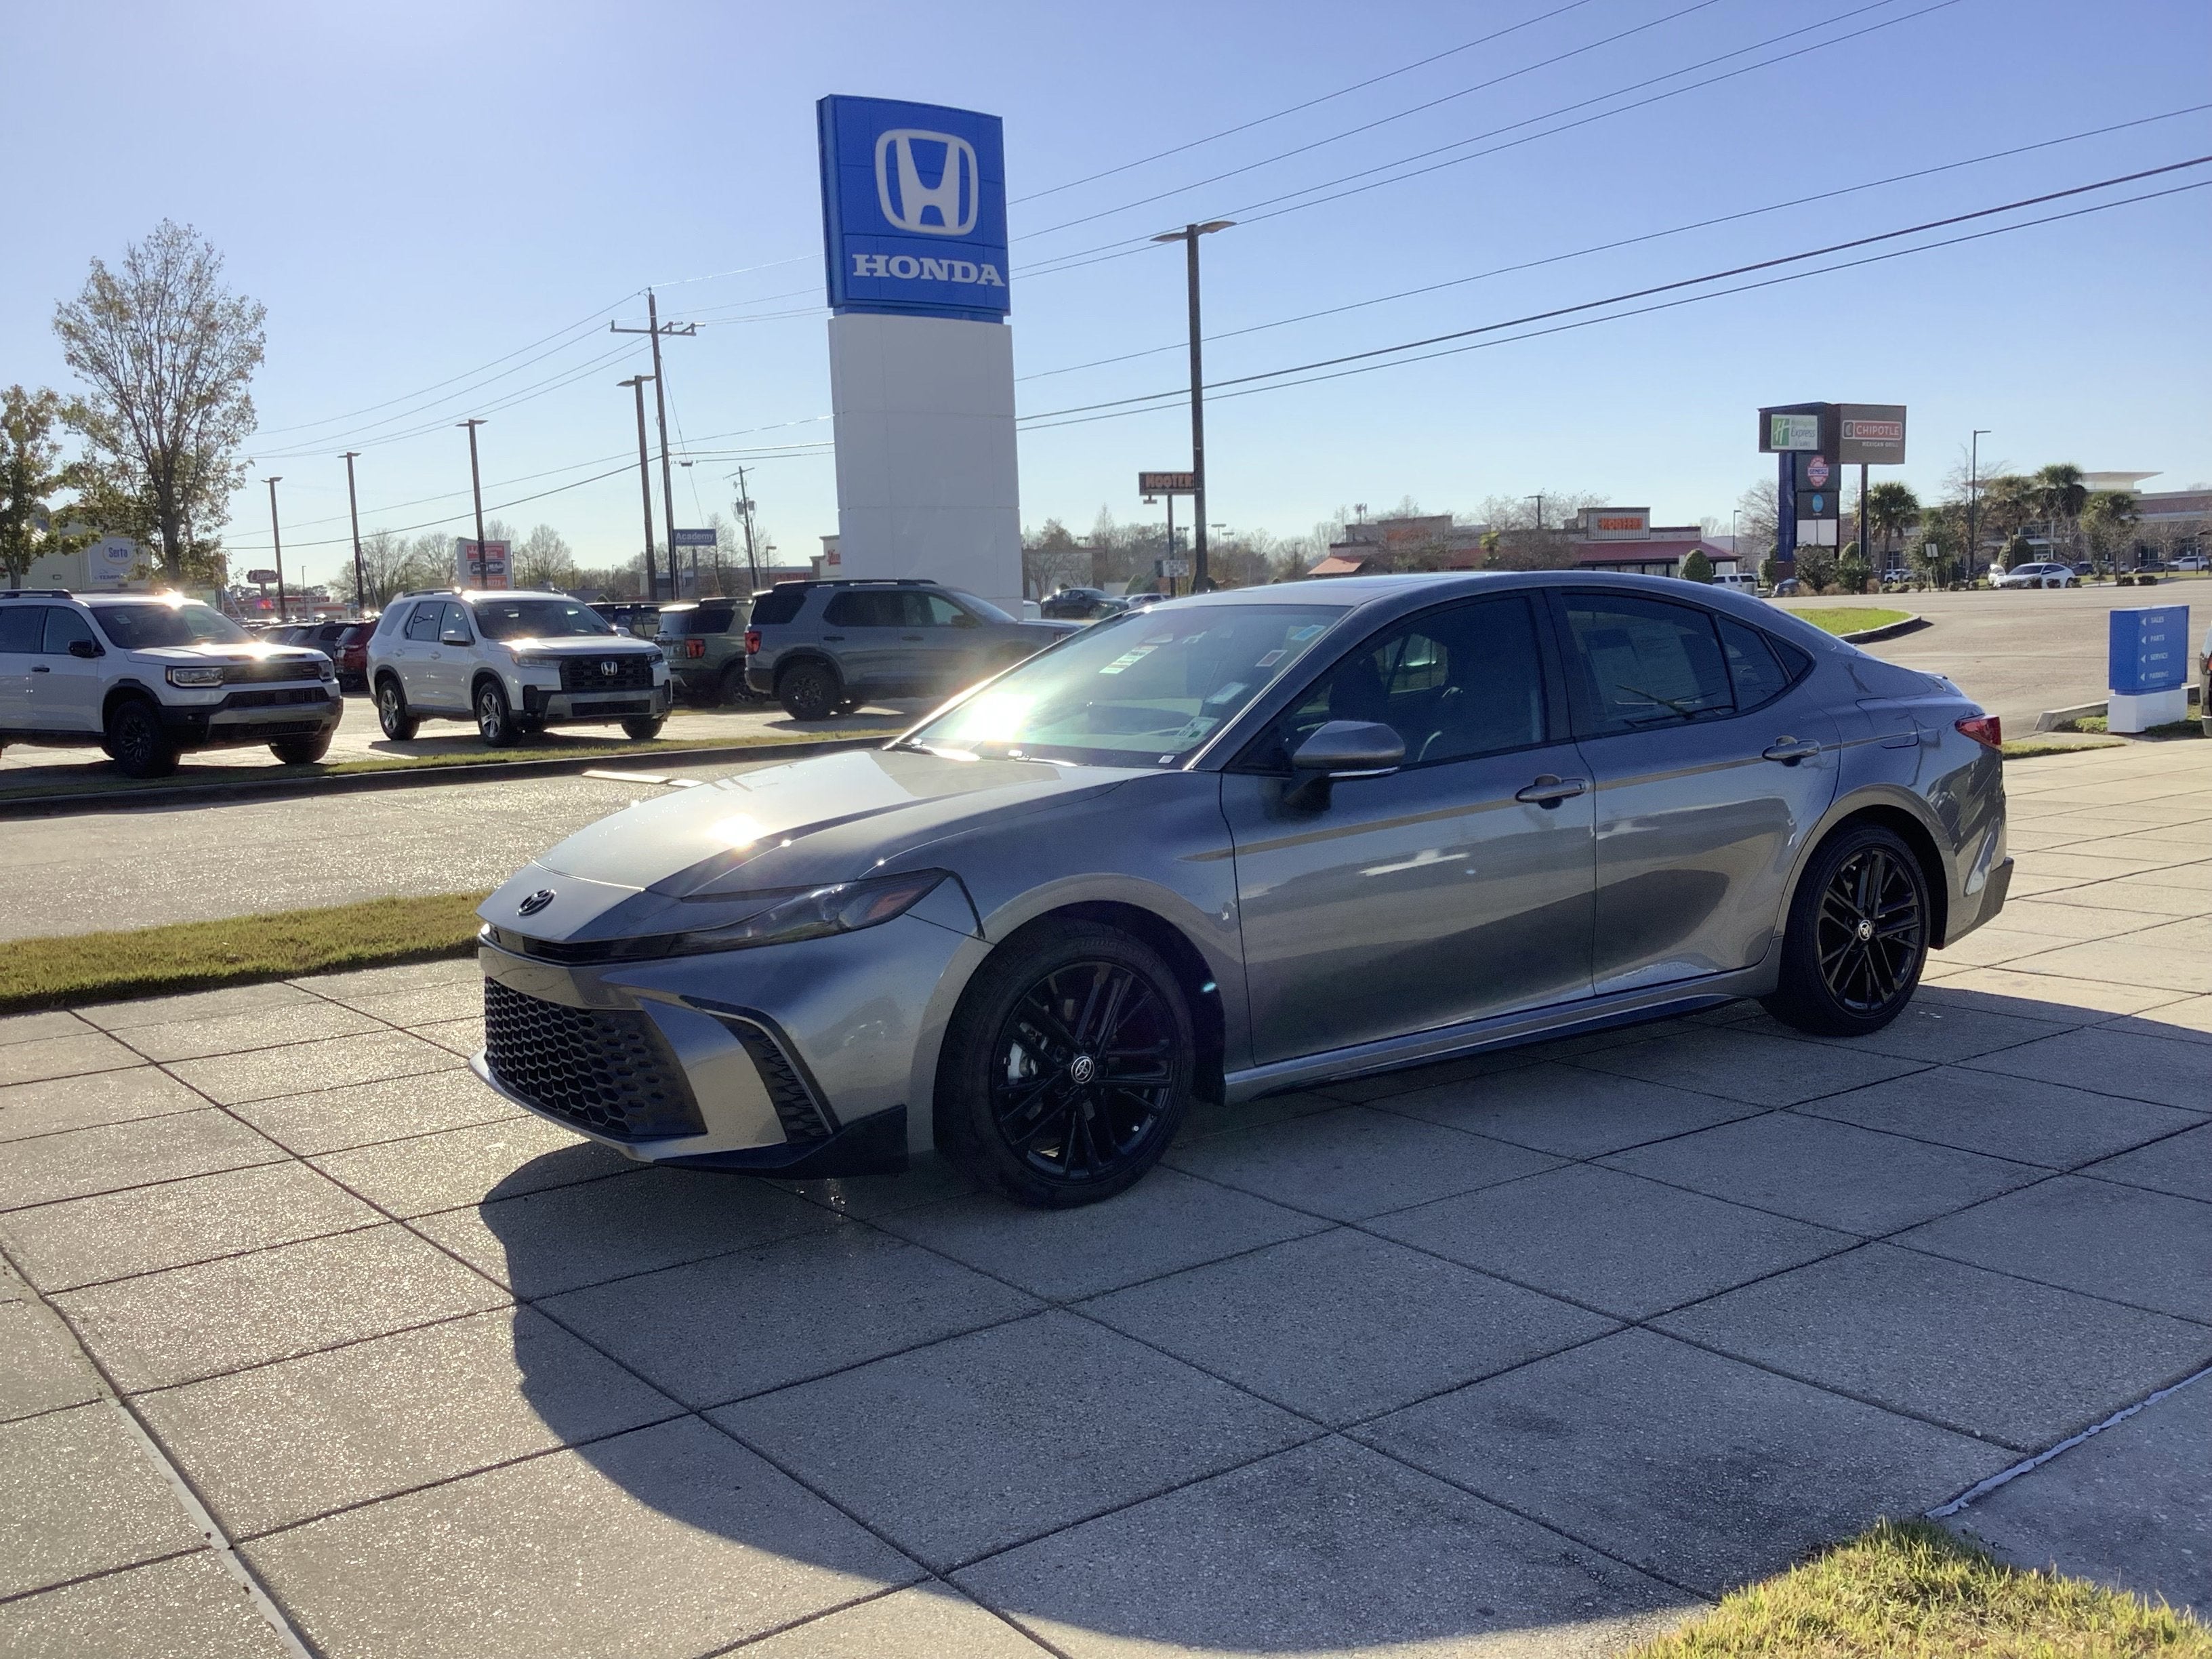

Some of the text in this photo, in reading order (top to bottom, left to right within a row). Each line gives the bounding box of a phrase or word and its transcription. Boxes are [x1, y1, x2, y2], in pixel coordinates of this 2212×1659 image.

[852, 253, 1006, 287] HONDA
[1791, 426, 1816, 439] Express
[1856, 425, 1900, 436] CHIPOTLE
[1145, 474, 1194, 488] HOOTER
[676, 532, 714, 542] Academy
[108, 547, 128, 558] Serta
[2150, 653, 2168, 661] SERVICE
[2150, 671, 2169, 679] PARKING
